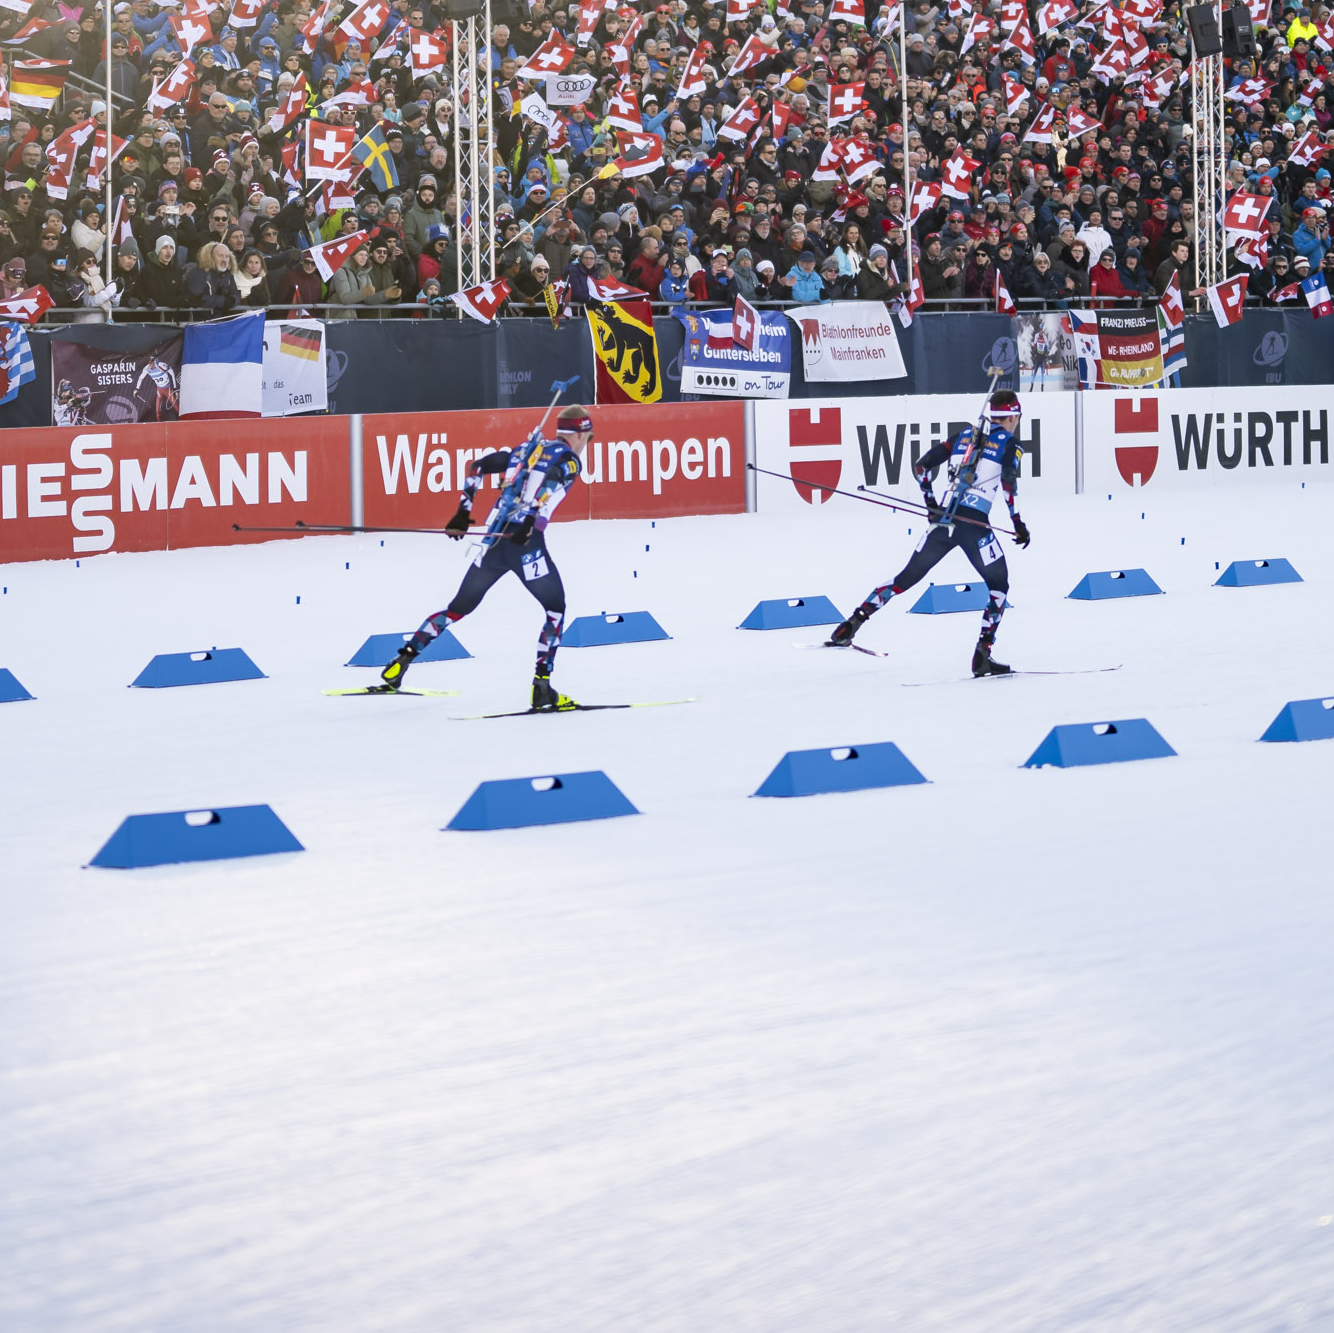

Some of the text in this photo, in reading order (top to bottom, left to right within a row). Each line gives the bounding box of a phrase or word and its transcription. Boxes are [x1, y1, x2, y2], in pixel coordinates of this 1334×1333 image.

[1100, 317, 1123, 328] FRANZI
[821, 323, 892, 340] Biathlonfreunde
[1059, 334, 1071, 350] Go
[1119, 341, 1155, 356] RHEINLAND
[830, 346, 886, 362] Mainfranken
[90, 361, 136, 375] GASPARIN
[97, 374, 133, 386] SISTERS
[273, 379, 284, 389] das
[761, 375, 786, 391] Tour
[1265, 372, 1282, 384] IBU
[288, 393, 313, 406] Team
[1171, 409, 1329, 471] WÜRTH
[989, 545, 997, 560] 4
[532, 562, 541, 578] 2
